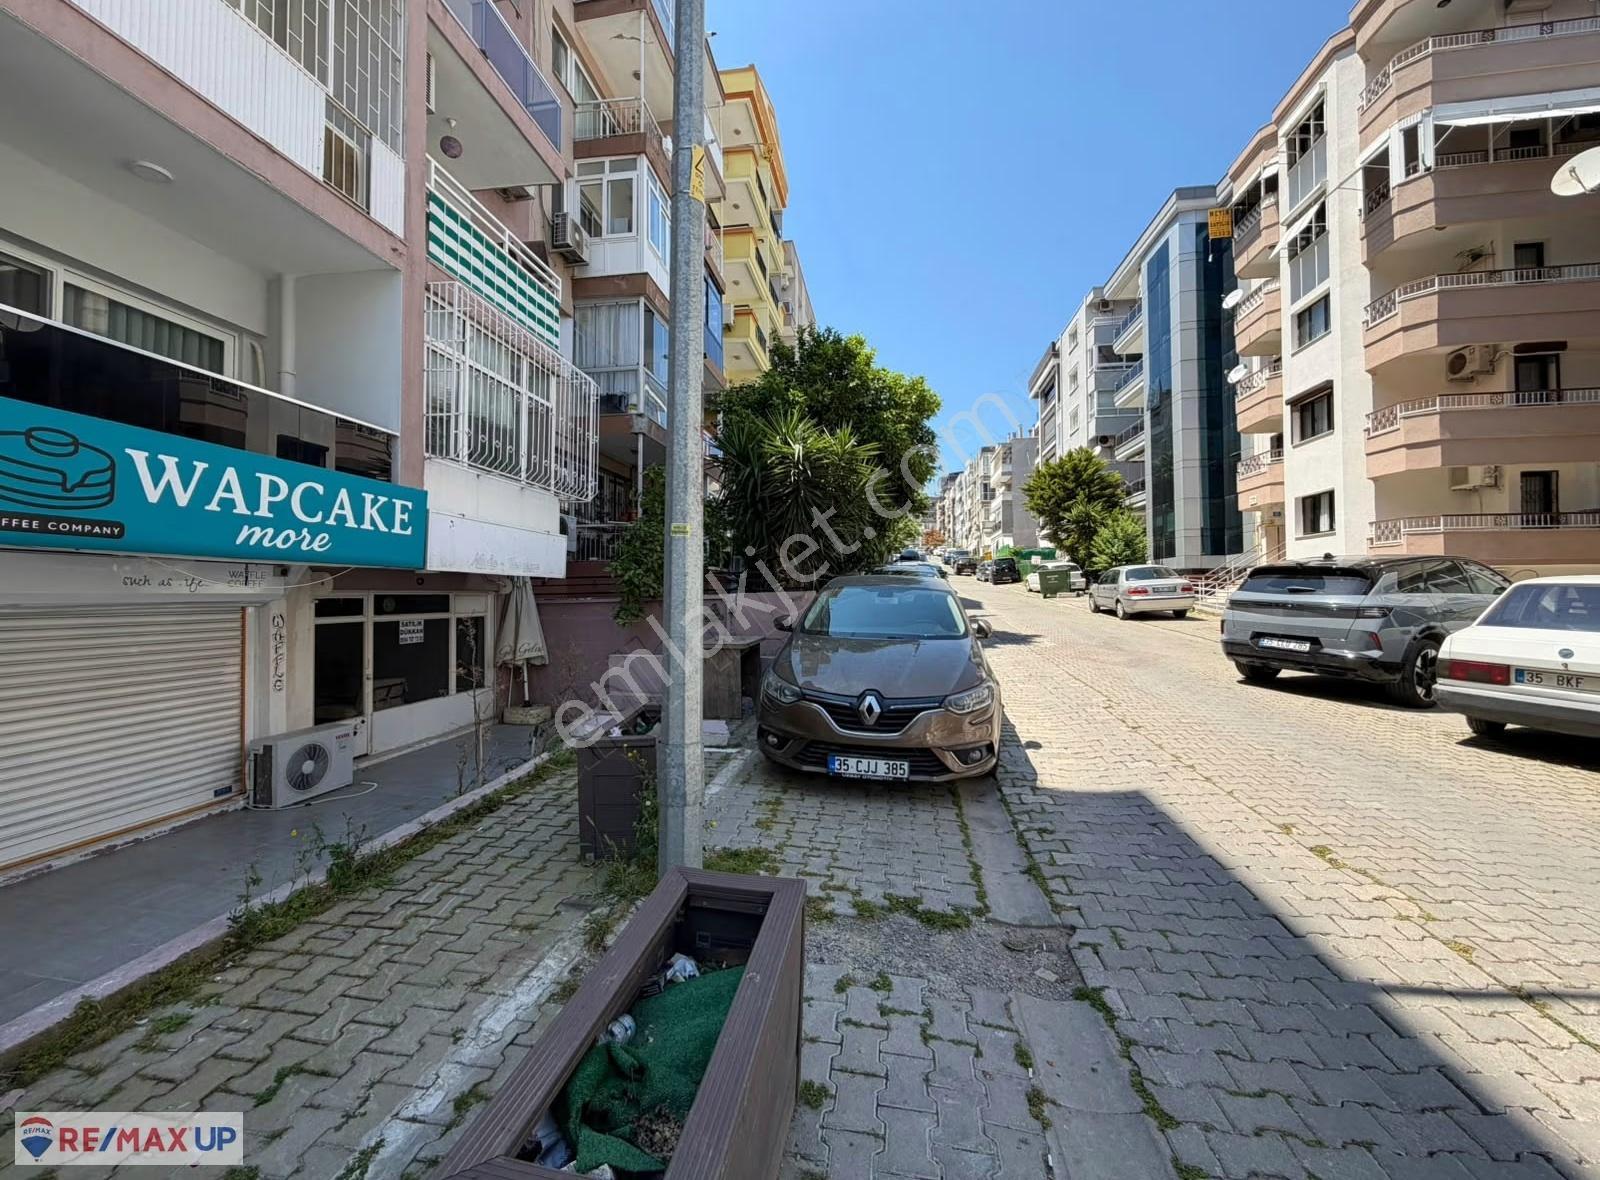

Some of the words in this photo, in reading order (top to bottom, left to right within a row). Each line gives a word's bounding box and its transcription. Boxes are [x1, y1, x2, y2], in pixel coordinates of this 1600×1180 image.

[124, 447, 414, 535] WAPCAKE
[48, 521, 121, 535] COMPANY
[235, 523, 332, 552] more
[122, 574, 151, 587] such
[158, 577, 173, 587] as
[228, 570, 266, 580] WAFLE
[1526, 672, 1544, 684] 35
[1556, 675, 1584, 688] BKF
[836, 758, 850, 772] 35
[856, 760, 878, 774] CJJ
[884, 762, 906, 776] 385
